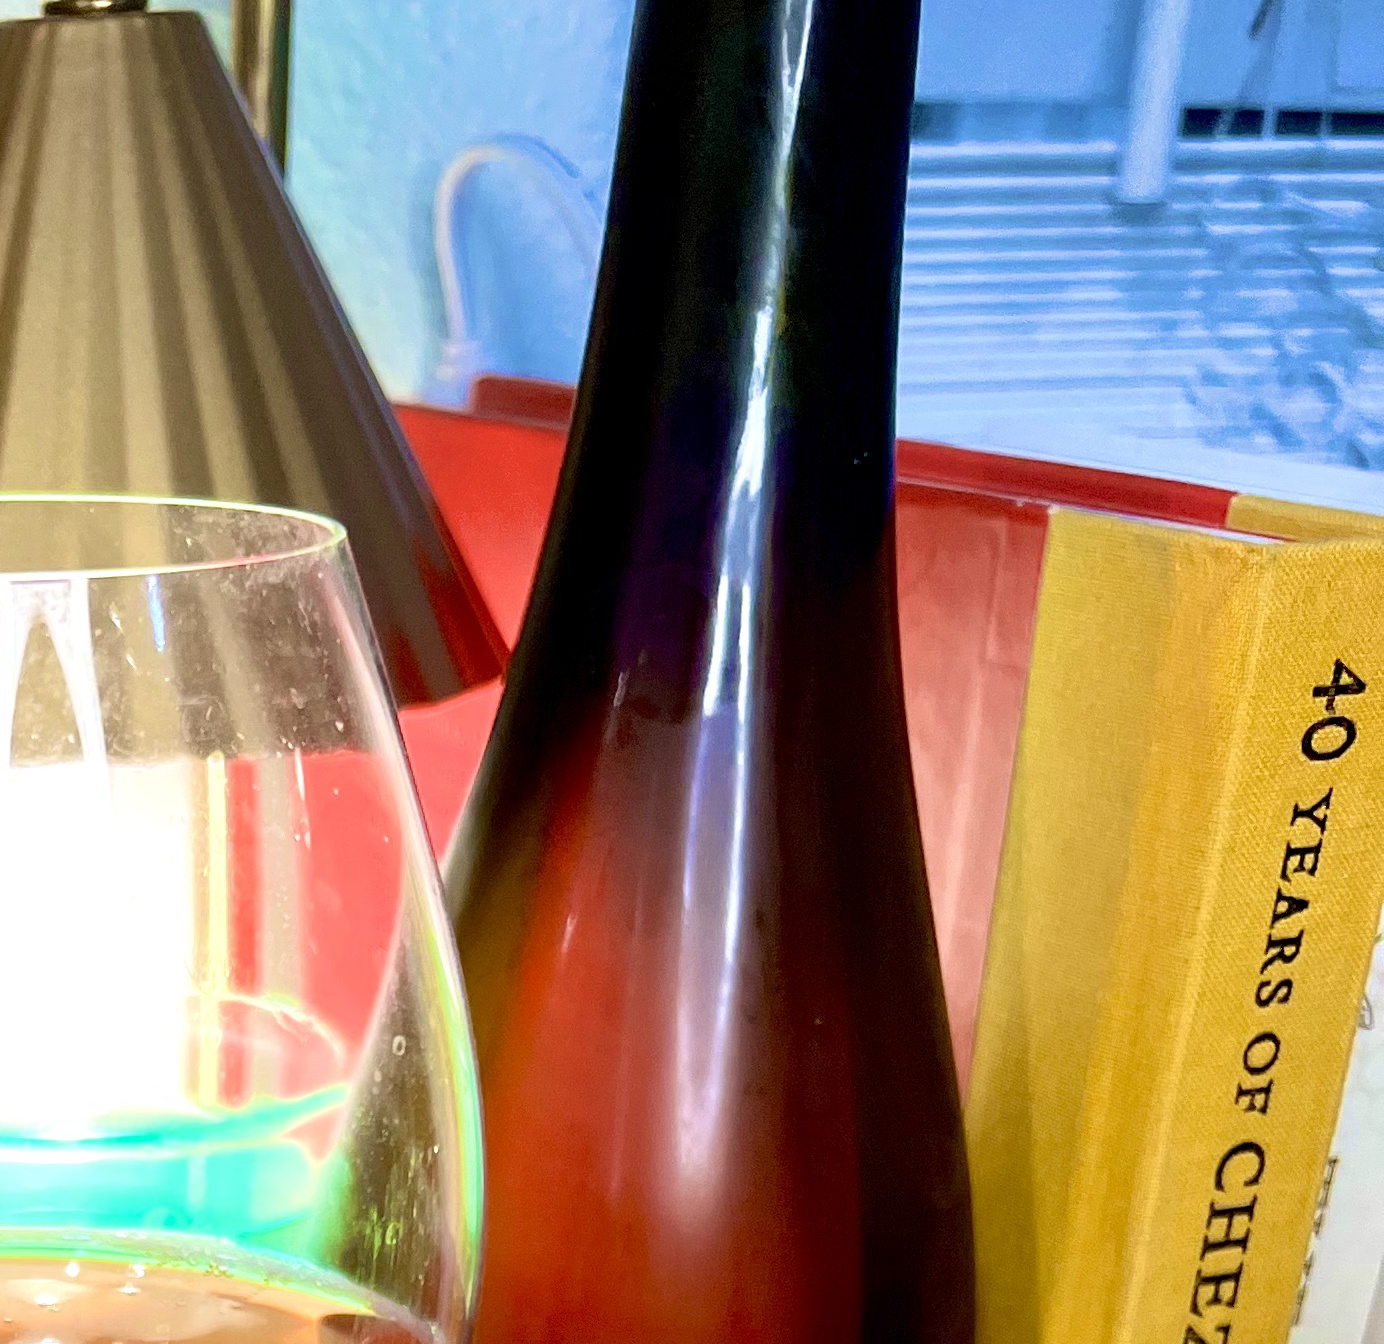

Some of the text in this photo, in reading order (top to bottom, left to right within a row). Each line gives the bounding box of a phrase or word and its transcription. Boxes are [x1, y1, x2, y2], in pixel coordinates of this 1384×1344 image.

[1301, 659, 1367, 761] 40
[1255, 787, 1334, 1009] YEARS
[1235, 1032, 1282, 1116] OF
